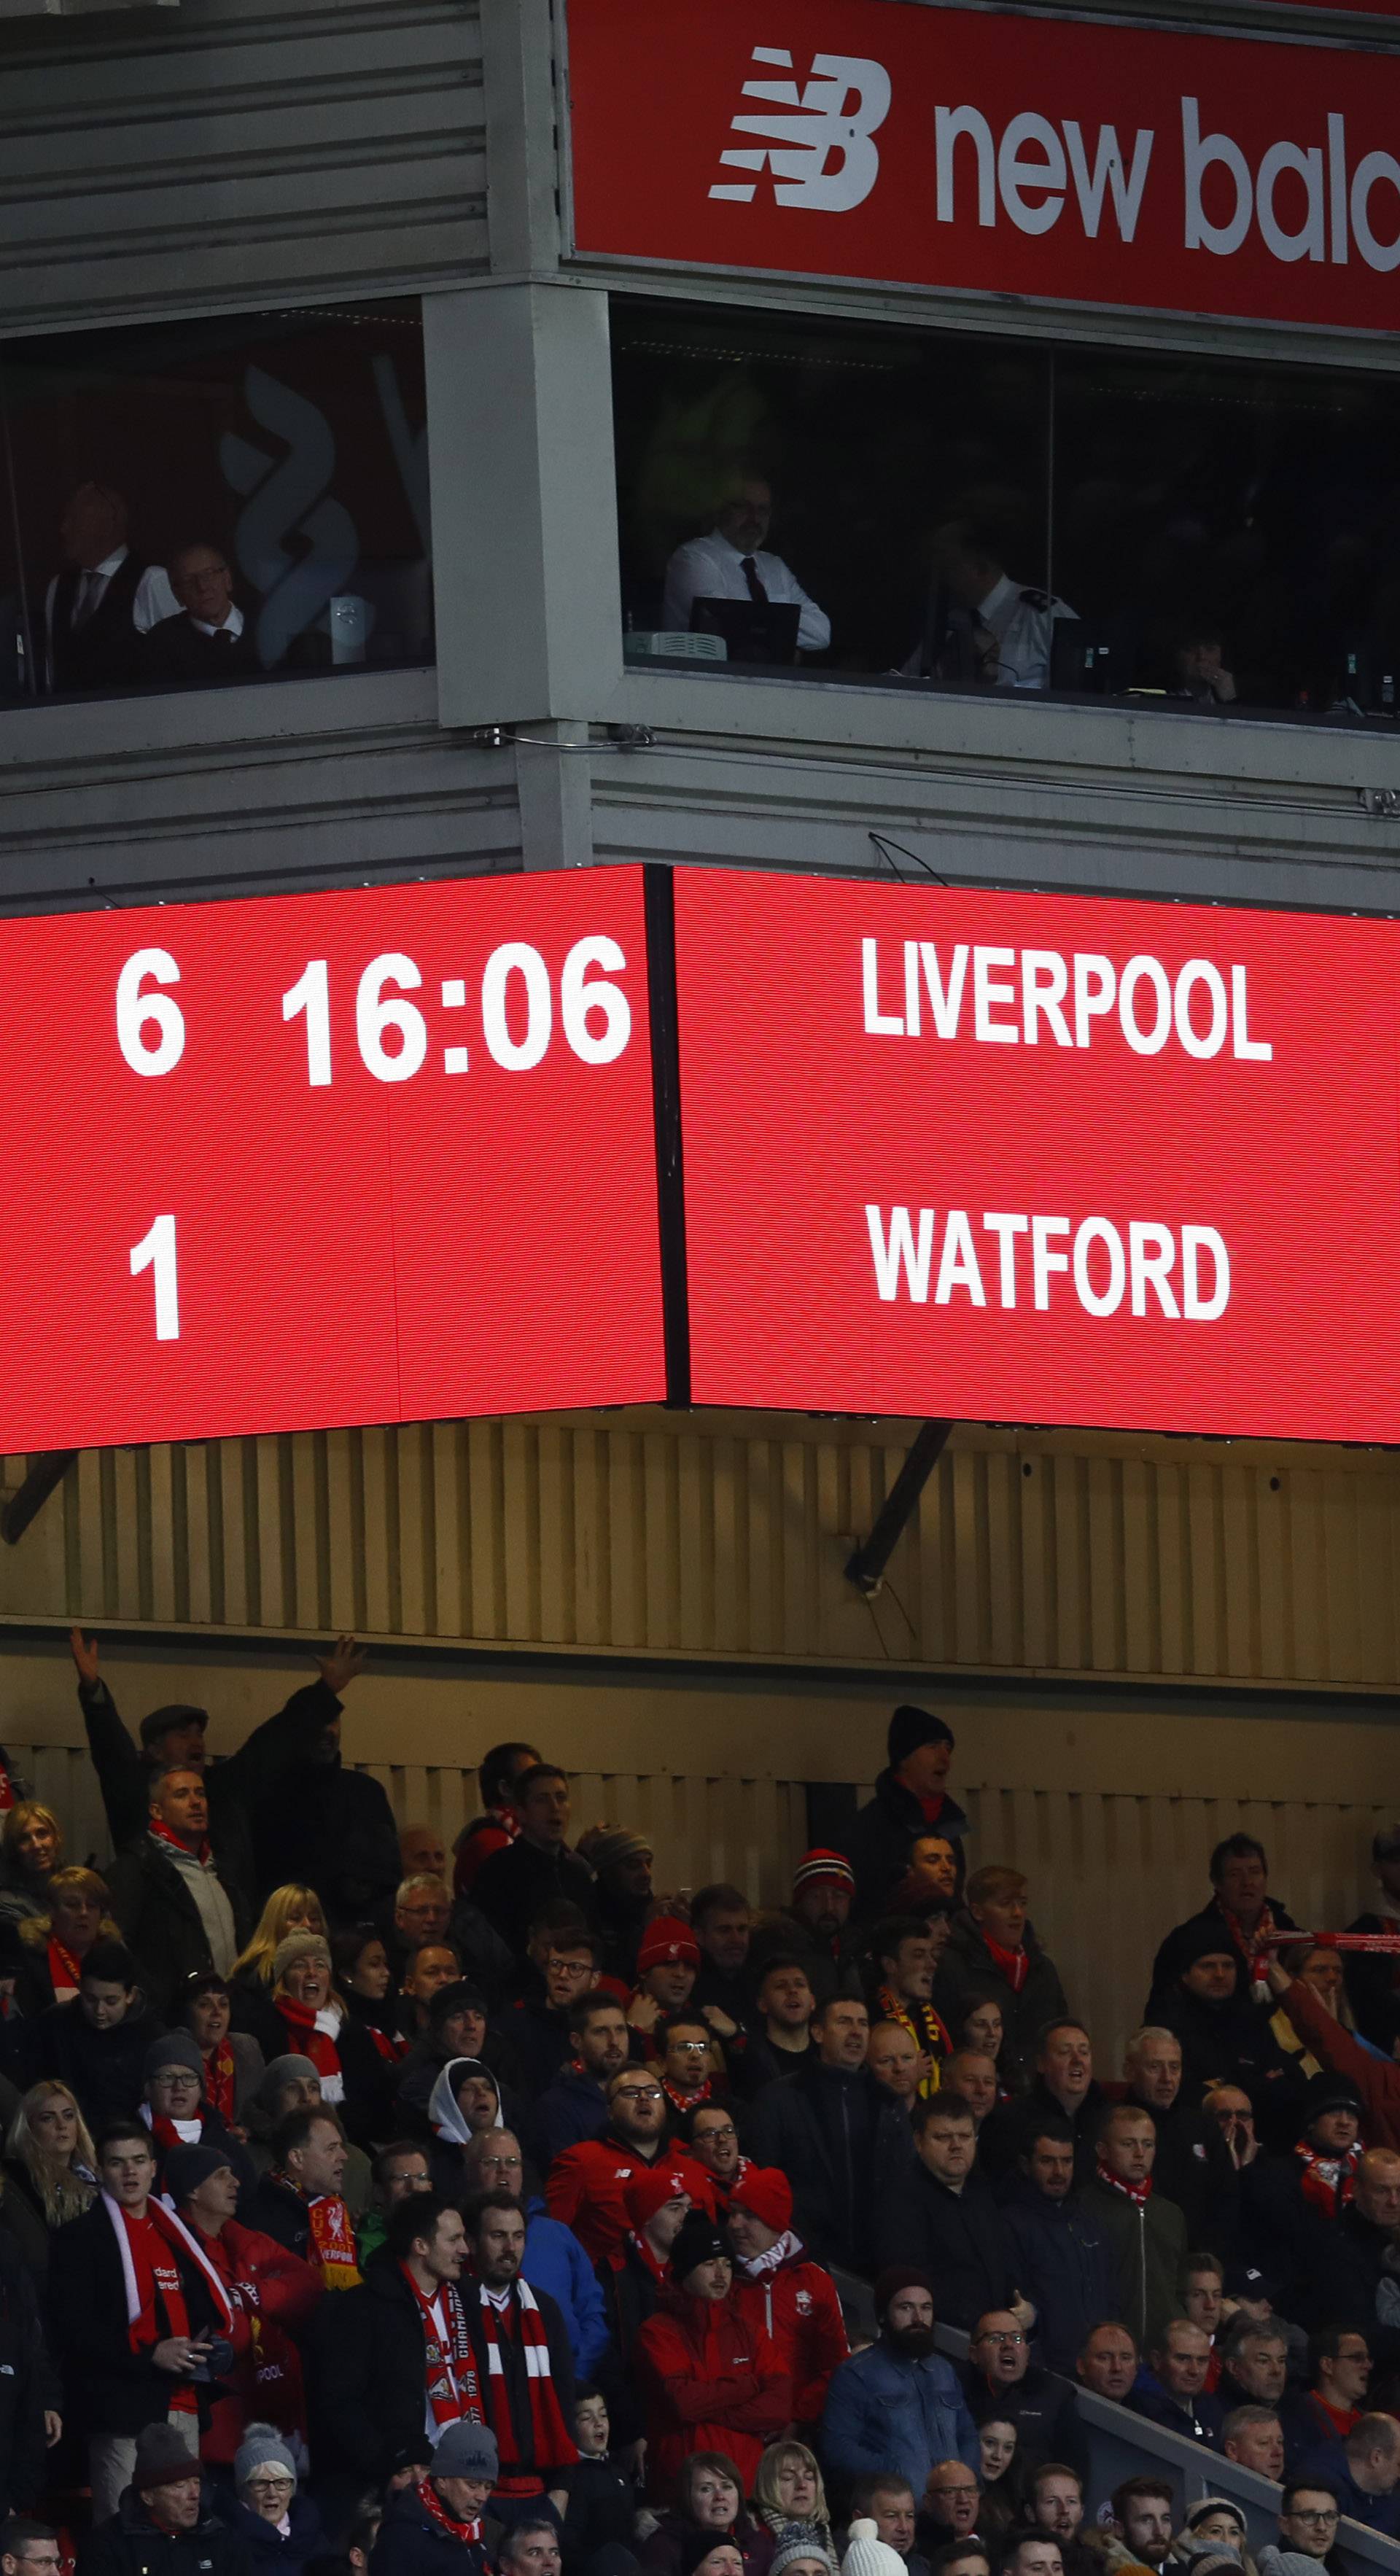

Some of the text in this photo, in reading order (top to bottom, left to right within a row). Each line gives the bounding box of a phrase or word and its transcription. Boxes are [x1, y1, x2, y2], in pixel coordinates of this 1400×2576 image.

[936, 106, 1154, 242] new
[117, 936, 631, 1086] 6 16:06
[863, 938, 1272, 1061] LIVERPOOL
[130, 1215, 179, 1341] 1
[866, 1205, 1231, 1320] WATFORD
[153, 2267, 178, 2279] dard
[470, 2405, 482, 2426] 977
